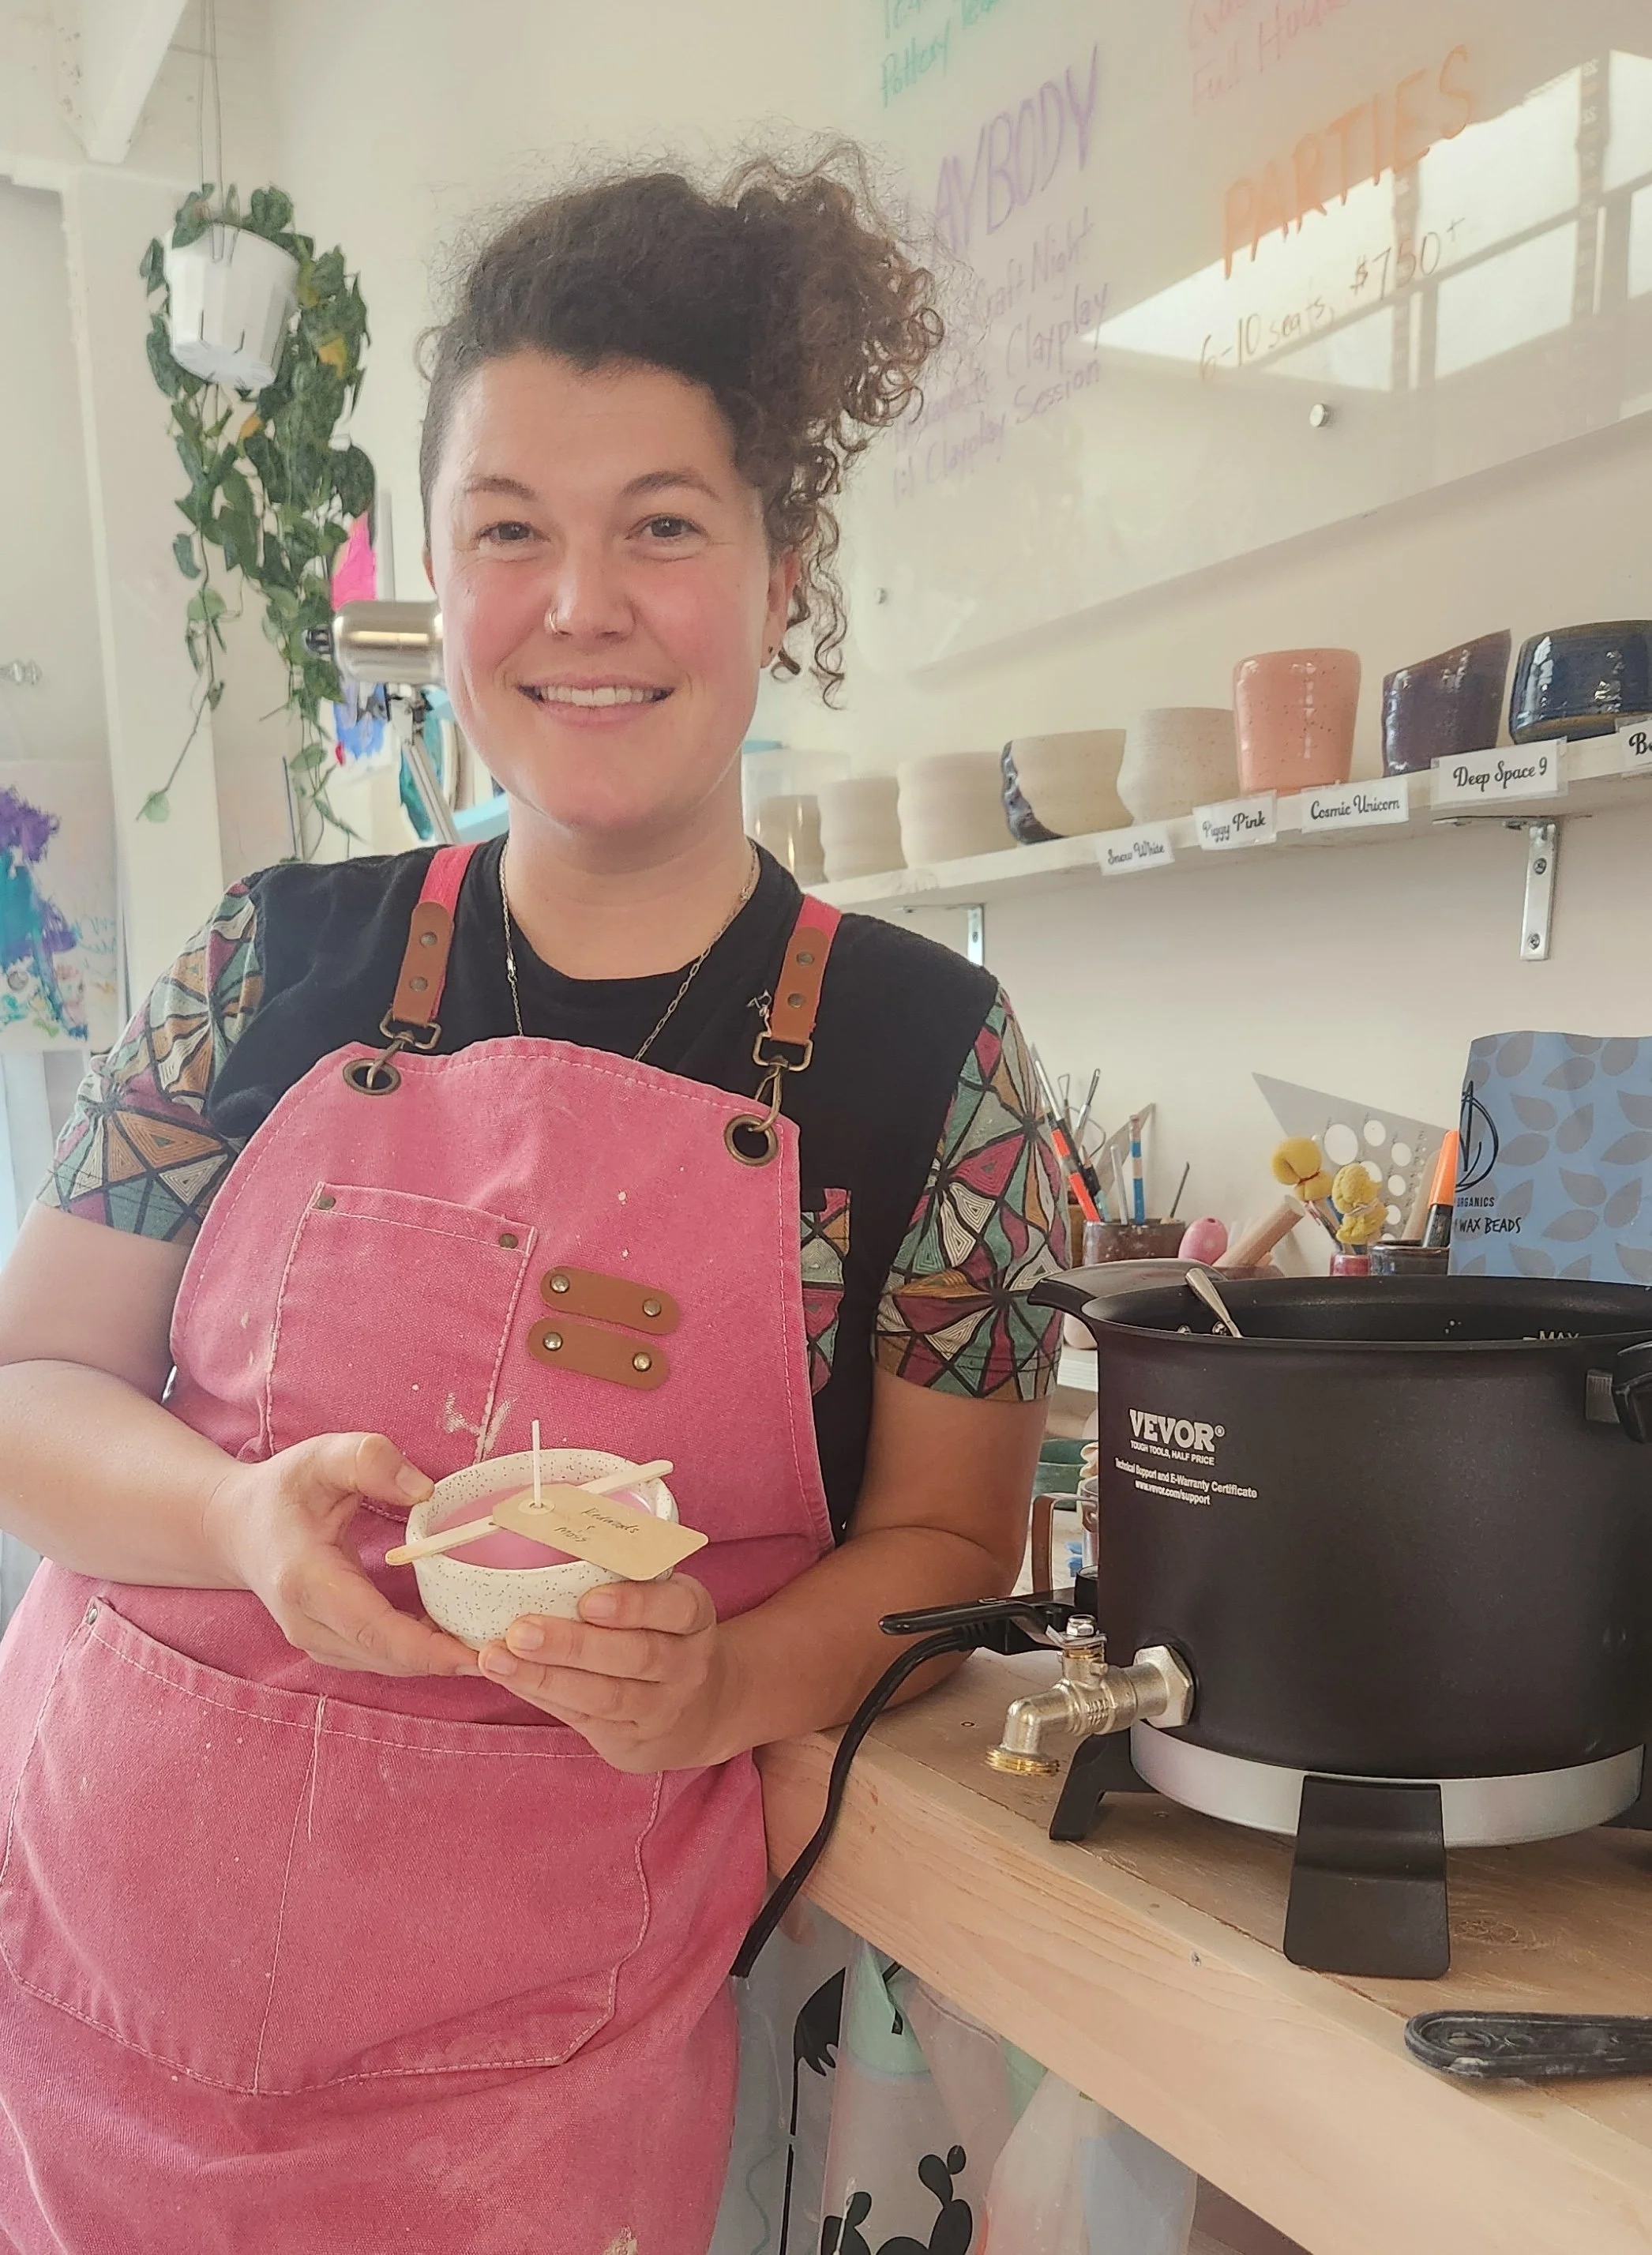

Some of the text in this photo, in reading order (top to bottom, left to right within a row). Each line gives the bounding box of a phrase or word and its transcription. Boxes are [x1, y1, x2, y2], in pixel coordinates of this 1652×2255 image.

[932, 39, 1098, 257] AYBODY
[1223, 44, 1474, 280] PARTIES
[1200, 313, 1261, 381] 6-10
[1013, 358, 1102, 424] Session
[1452, 757, 1548, 792] Deep Space 9
[1311, 795, 1401, 820] Cosmic Unicorn
[1202, 810, 1267, 843] Piggy Pink
[1108, 840, 1165, 866] Snow White
[1459, 1217, 1481, 1233] WAX
[1485, 1217, 1522, 1234] BEADS
[1130, 1440, 1215, 1466] TOUGH TOOLS, HALF PRICE
[1115, 1457, 1258, 1499] Technical Support and E-Warranty Certificate
